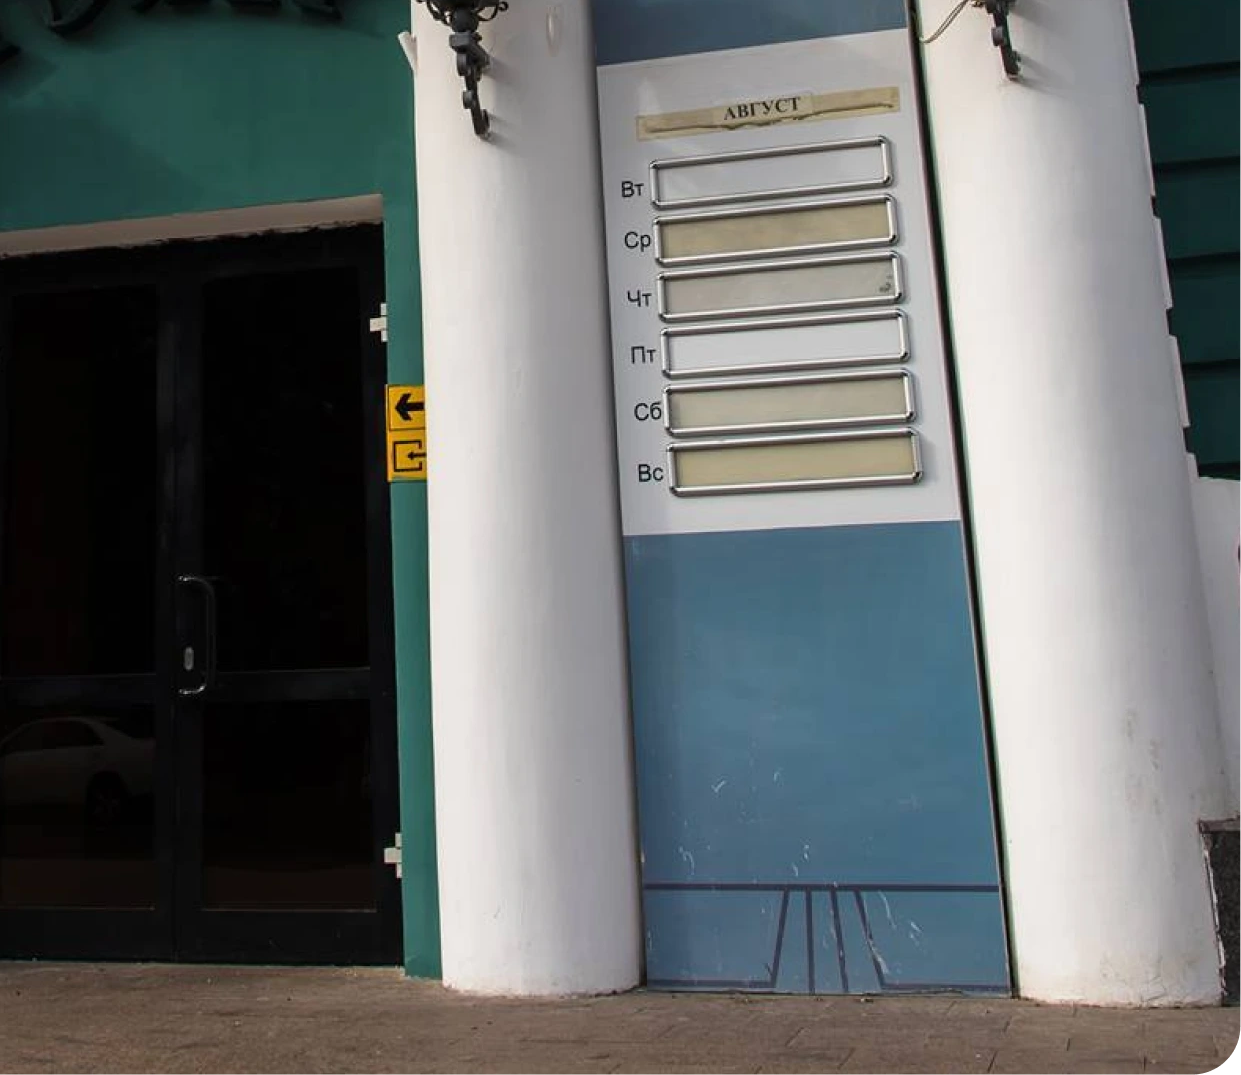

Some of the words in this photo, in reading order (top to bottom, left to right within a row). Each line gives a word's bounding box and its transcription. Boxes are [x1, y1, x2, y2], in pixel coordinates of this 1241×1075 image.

[724, 97, 800, 120] АВГУСТ
[620, 181, 645, 198] Вт
[624, 231, 651, 252] Ср
[626, 290, 652, 308] Чт
[631, 346, 656, 363] Пт
[633, 402, 662, 422] Сб
[637, 464, 665, 483] Вс
